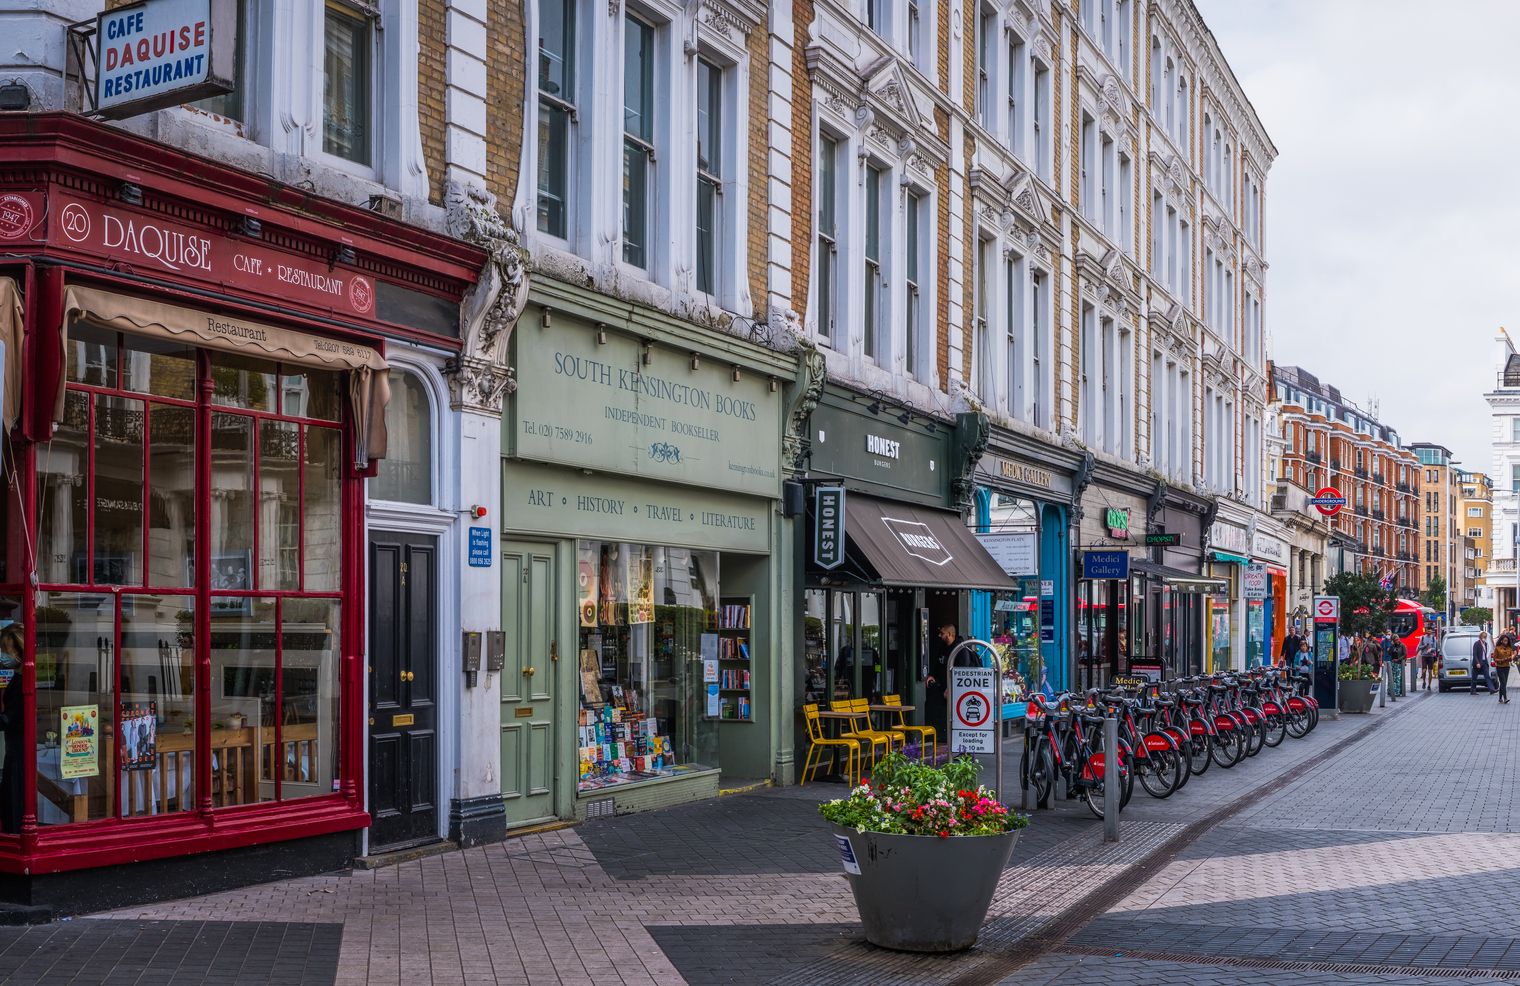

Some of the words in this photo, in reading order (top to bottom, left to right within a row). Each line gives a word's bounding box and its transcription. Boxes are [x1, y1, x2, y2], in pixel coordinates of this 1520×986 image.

[108, 12, 143, 39] CAFE
[106, 22, 205, 71] DAQUISE
[104, 54, 204, 98] RESTAURANT
[2, 211, 20, 223] 1947
[66, 211, 86, 232] 20
[103, 215, 211, 271] DAQUISE
[234, 254, 262, 275] CAFE
[278, 265, 343, 295] RESTAURANT
[207, 318, 267, 342] Restaurant
[555, 351, 612, 386] SOUTH
[618, 368, 710, 410] KENSINGTON
[715, 394, 757, 422] BOOKS
[523, 420, 537, 435] Tel.
[538, 424, 553, 438] 020
[554, 426, 574, 442] 7589
[575, 430, 593, 445] 2916
[604, 405, 667, 431] INDEPENDENT
[671, 420, 720, 443] BOOKSELLER
[867, 434, 900, 460] HONEST
[1002, 461, 1022, 481] MEDICI
[1024, 467, 1052, 488] GALLERY
[527, 489, 554, 507] ART
[577, 495, 625, 515] HISTORY
[646, 504, 682, 522] TRAVEL
[701, 511, 755, 531] LITERATURE
[822, 495, 836, 560] HONEST
[1091, 566, 1120, 575] Gallery
[1092, 555, 1120, 563] Medici
[957, 678, 989, 687] ZONE
[1115, 677, 1143, 686] Medici
